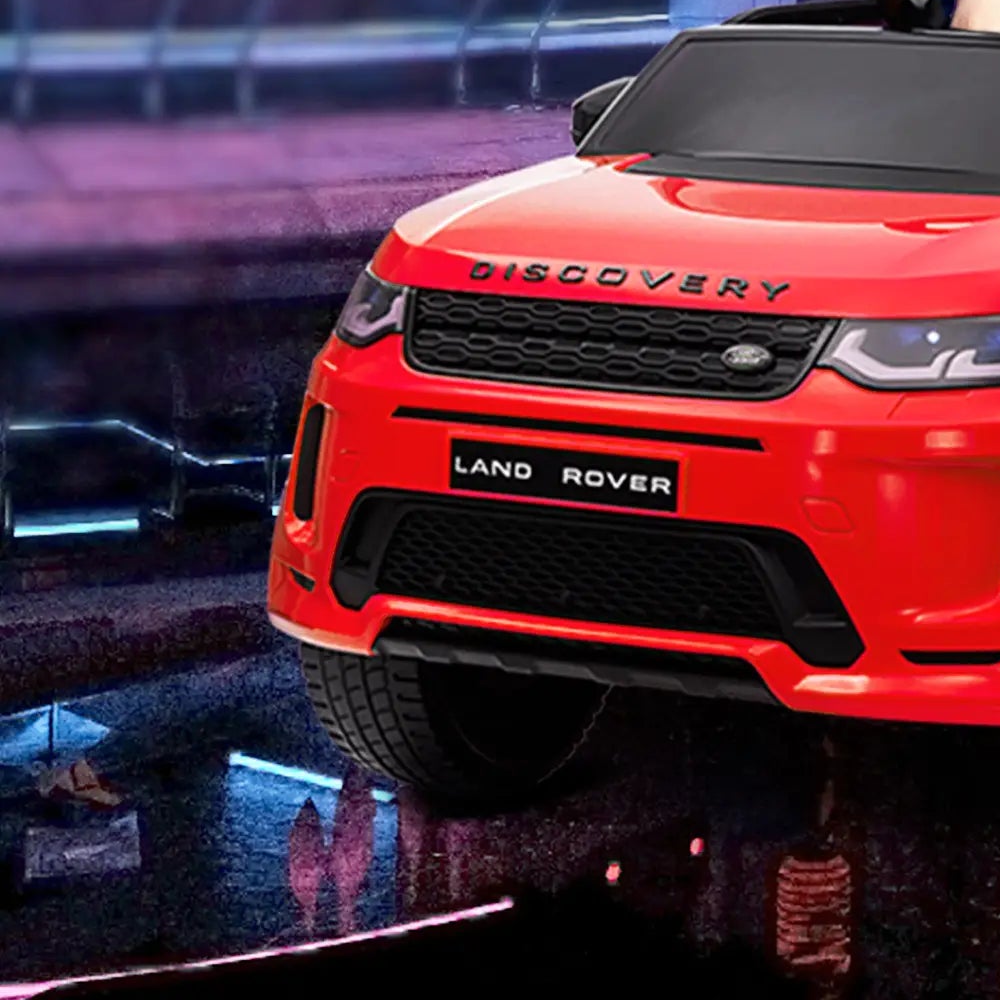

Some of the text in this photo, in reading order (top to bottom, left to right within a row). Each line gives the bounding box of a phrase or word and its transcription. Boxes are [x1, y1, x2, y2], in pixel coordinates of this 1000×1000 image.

[470, 261, 790, 301] DISCOVERY
[454, 456, 672, 495] LAND ROVER
